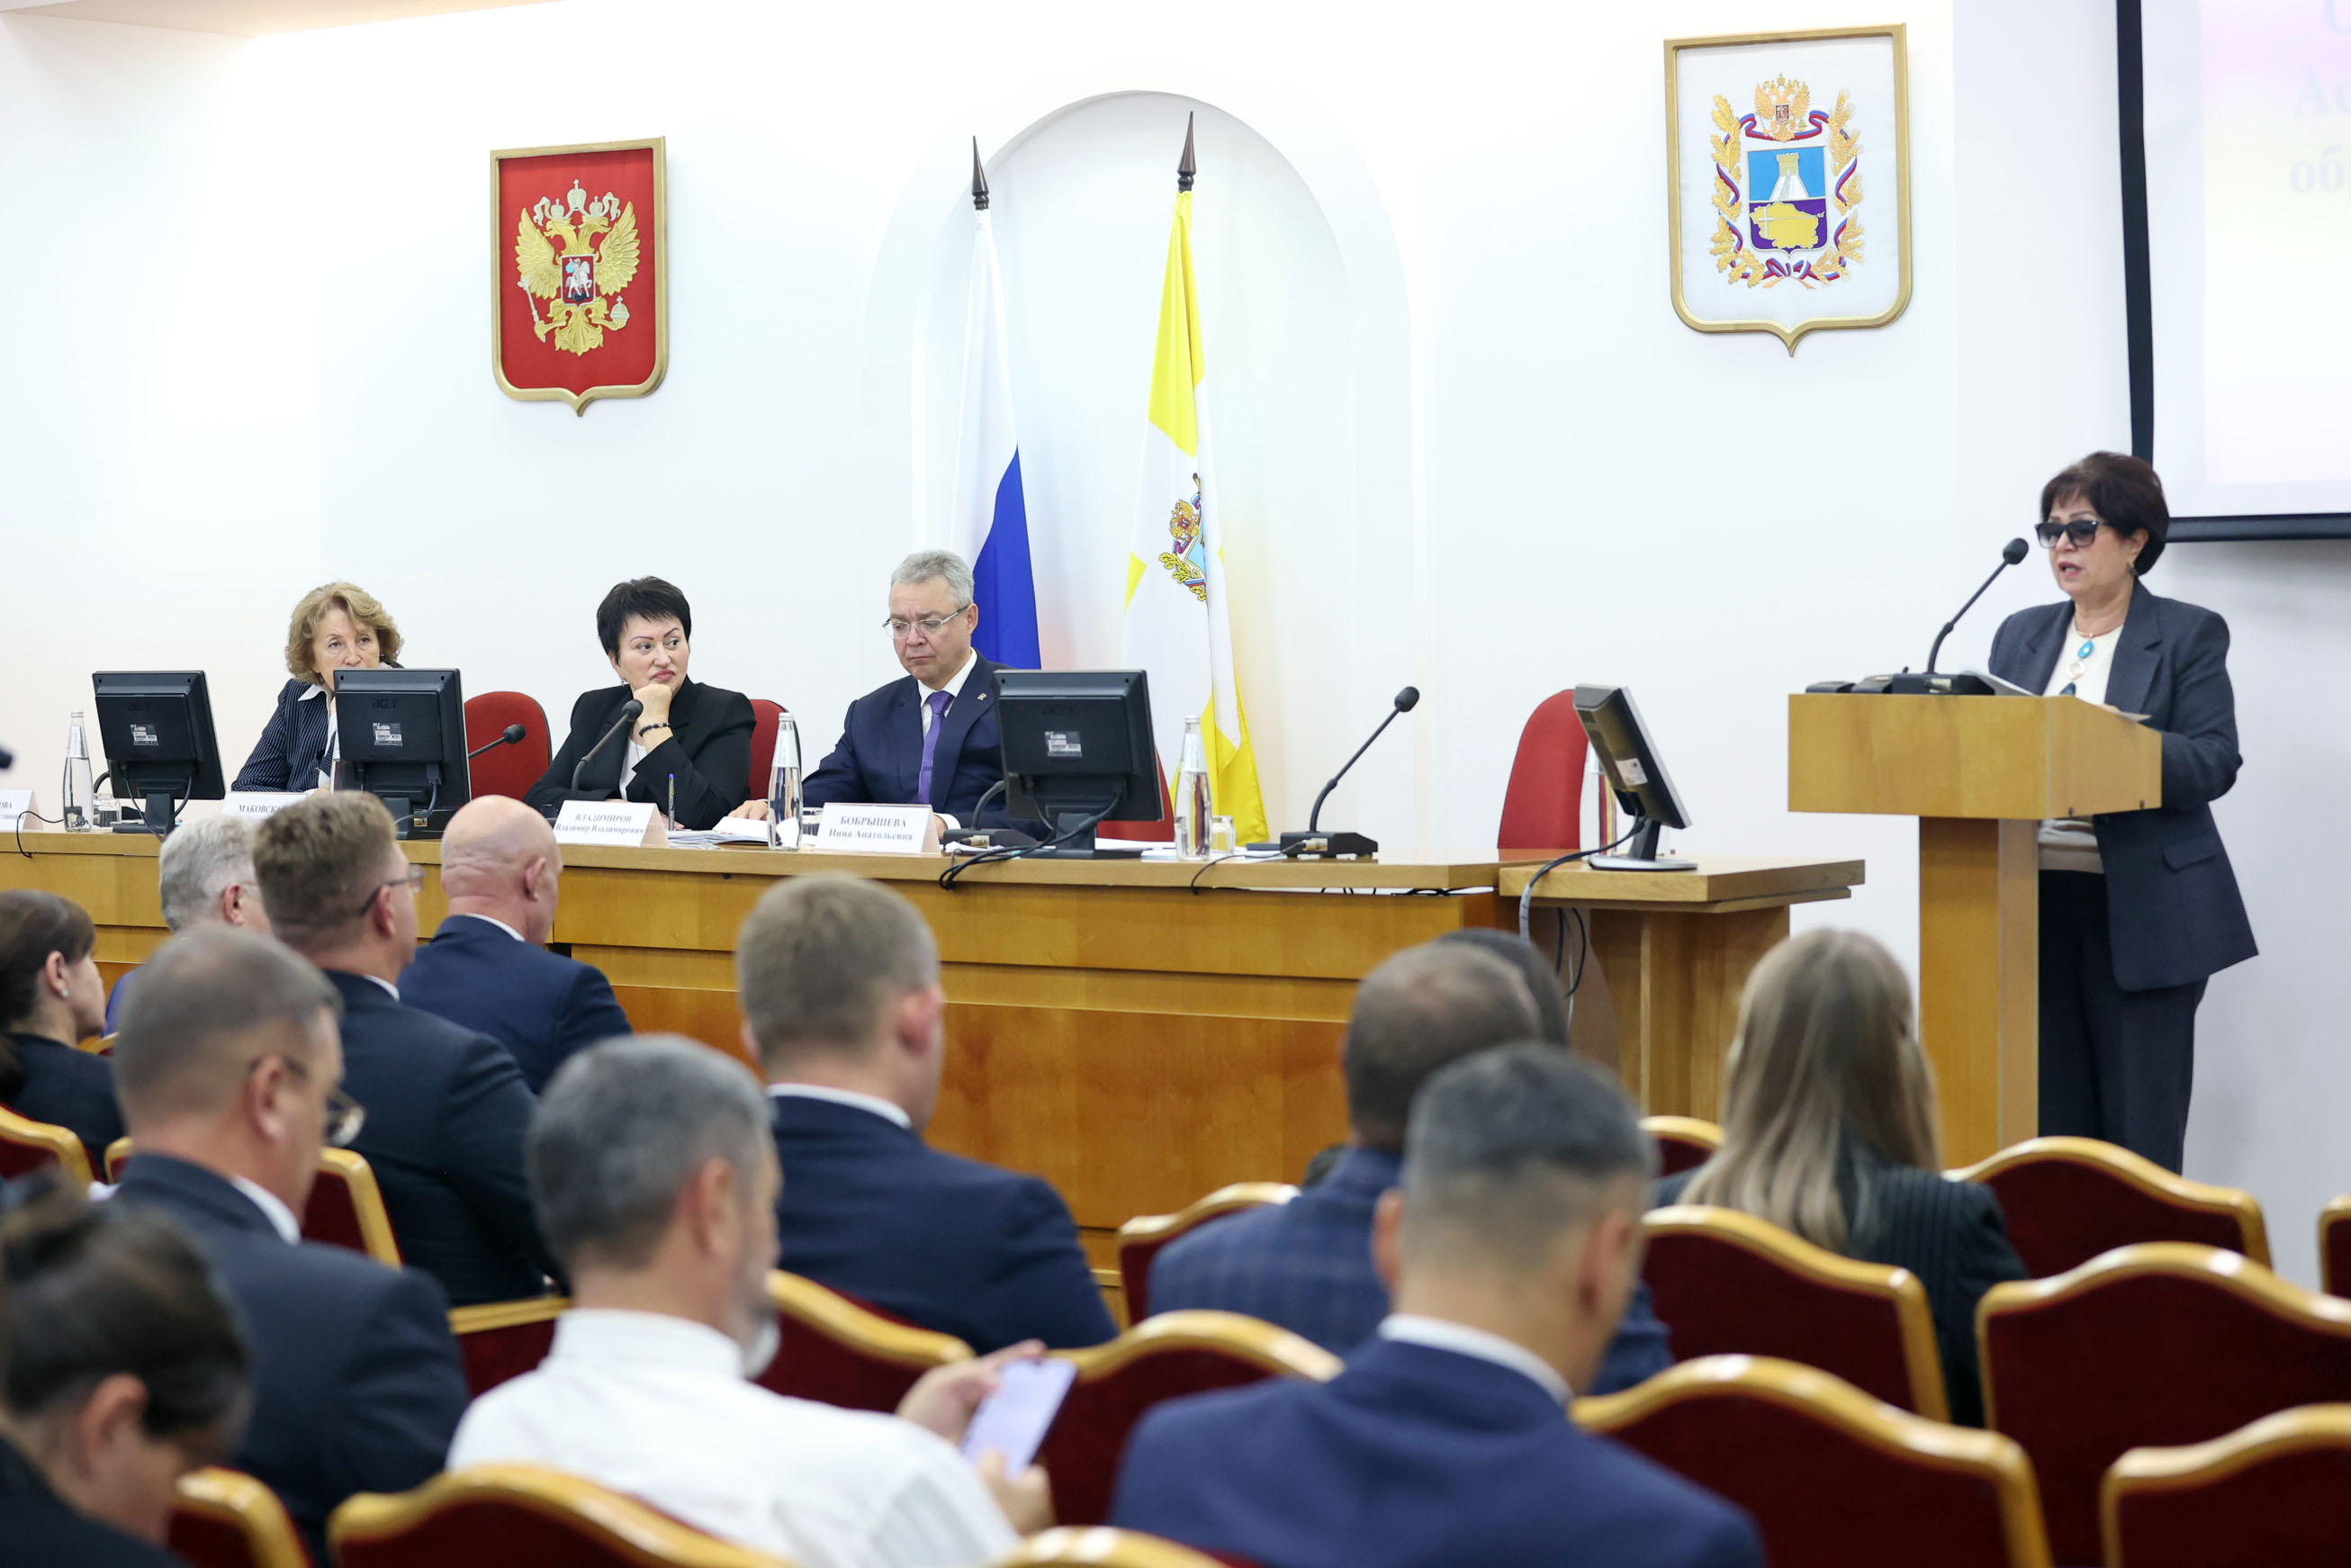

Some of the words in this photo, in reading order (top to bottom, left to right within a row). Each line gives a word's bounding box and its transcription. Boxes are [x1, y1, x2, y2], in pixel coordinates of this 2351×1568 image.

[2290, 143, 2351, 203] об
[575, 814, 632, 823] ВЛАДИМИРОВ
[840, 816, 906, 827] БОБРЫШЕВА
[555, 825, 590, 834] Владимир
[829, 828, 851, 838] Нина
[855, 829, 913, 841] Анатольевна
